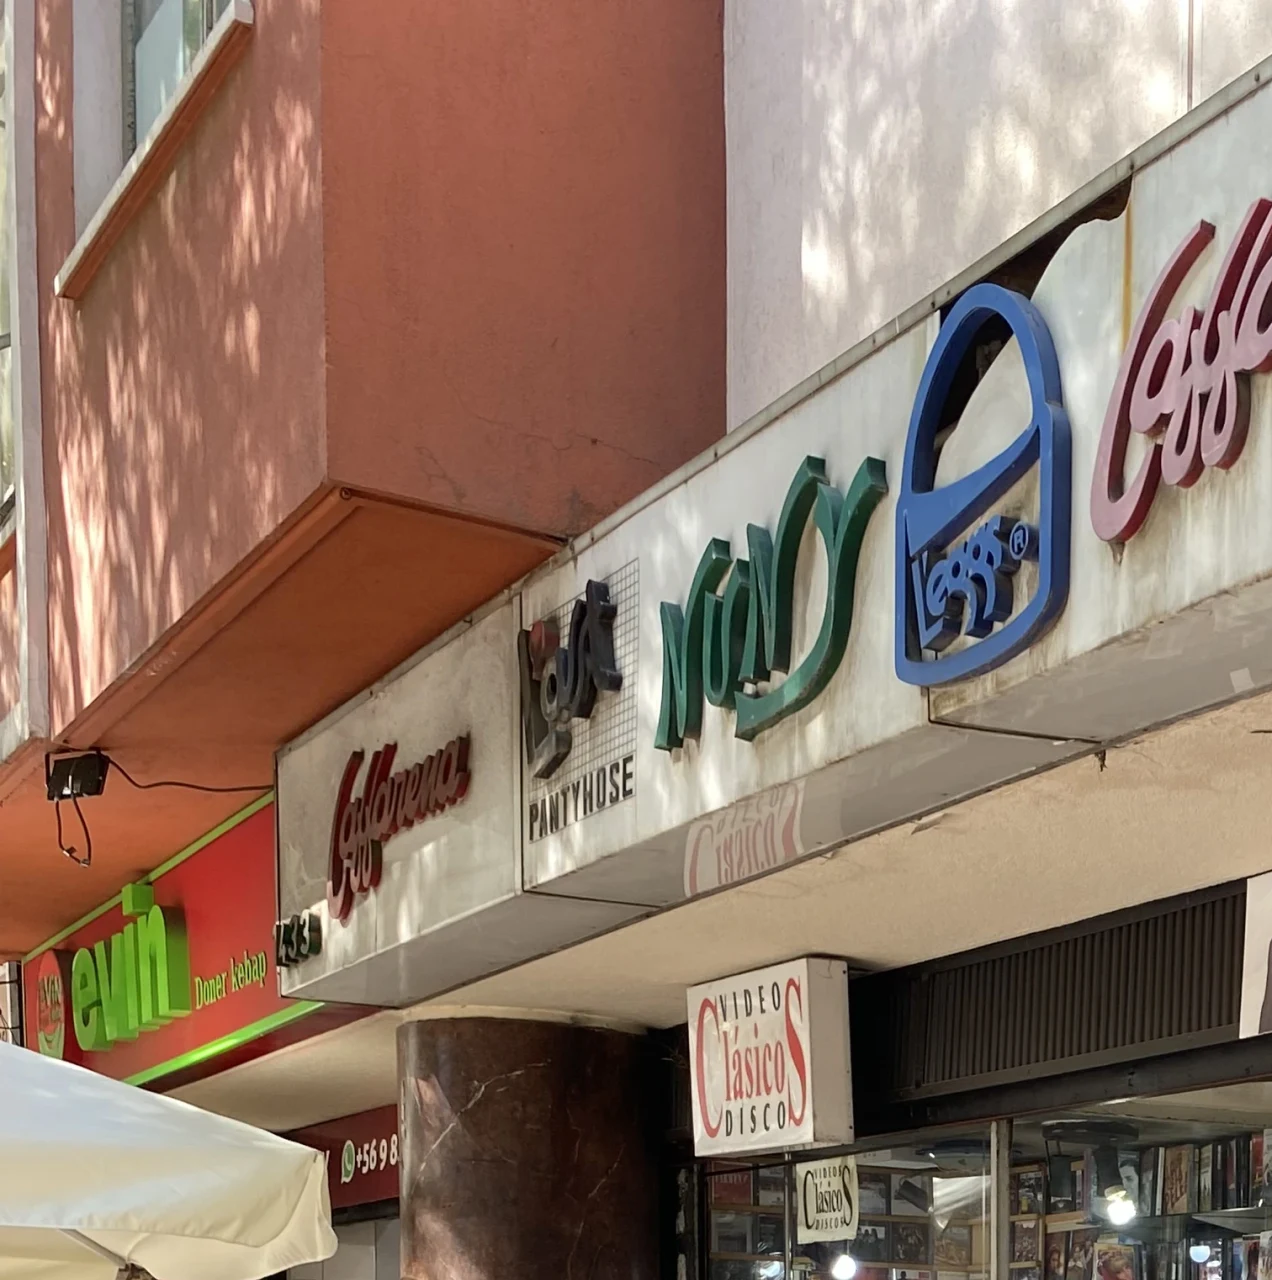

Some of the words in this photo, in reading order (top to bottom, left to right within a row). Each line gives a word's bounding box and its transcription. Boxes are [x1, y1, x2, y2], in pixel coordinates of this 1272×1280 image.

[528, 755, 634, 842] PANTYHOSE
[71, 882, 192, 1052] evin
[195, 970, 229, 1010] Doner
[230, 949, 267, 993] kebap
